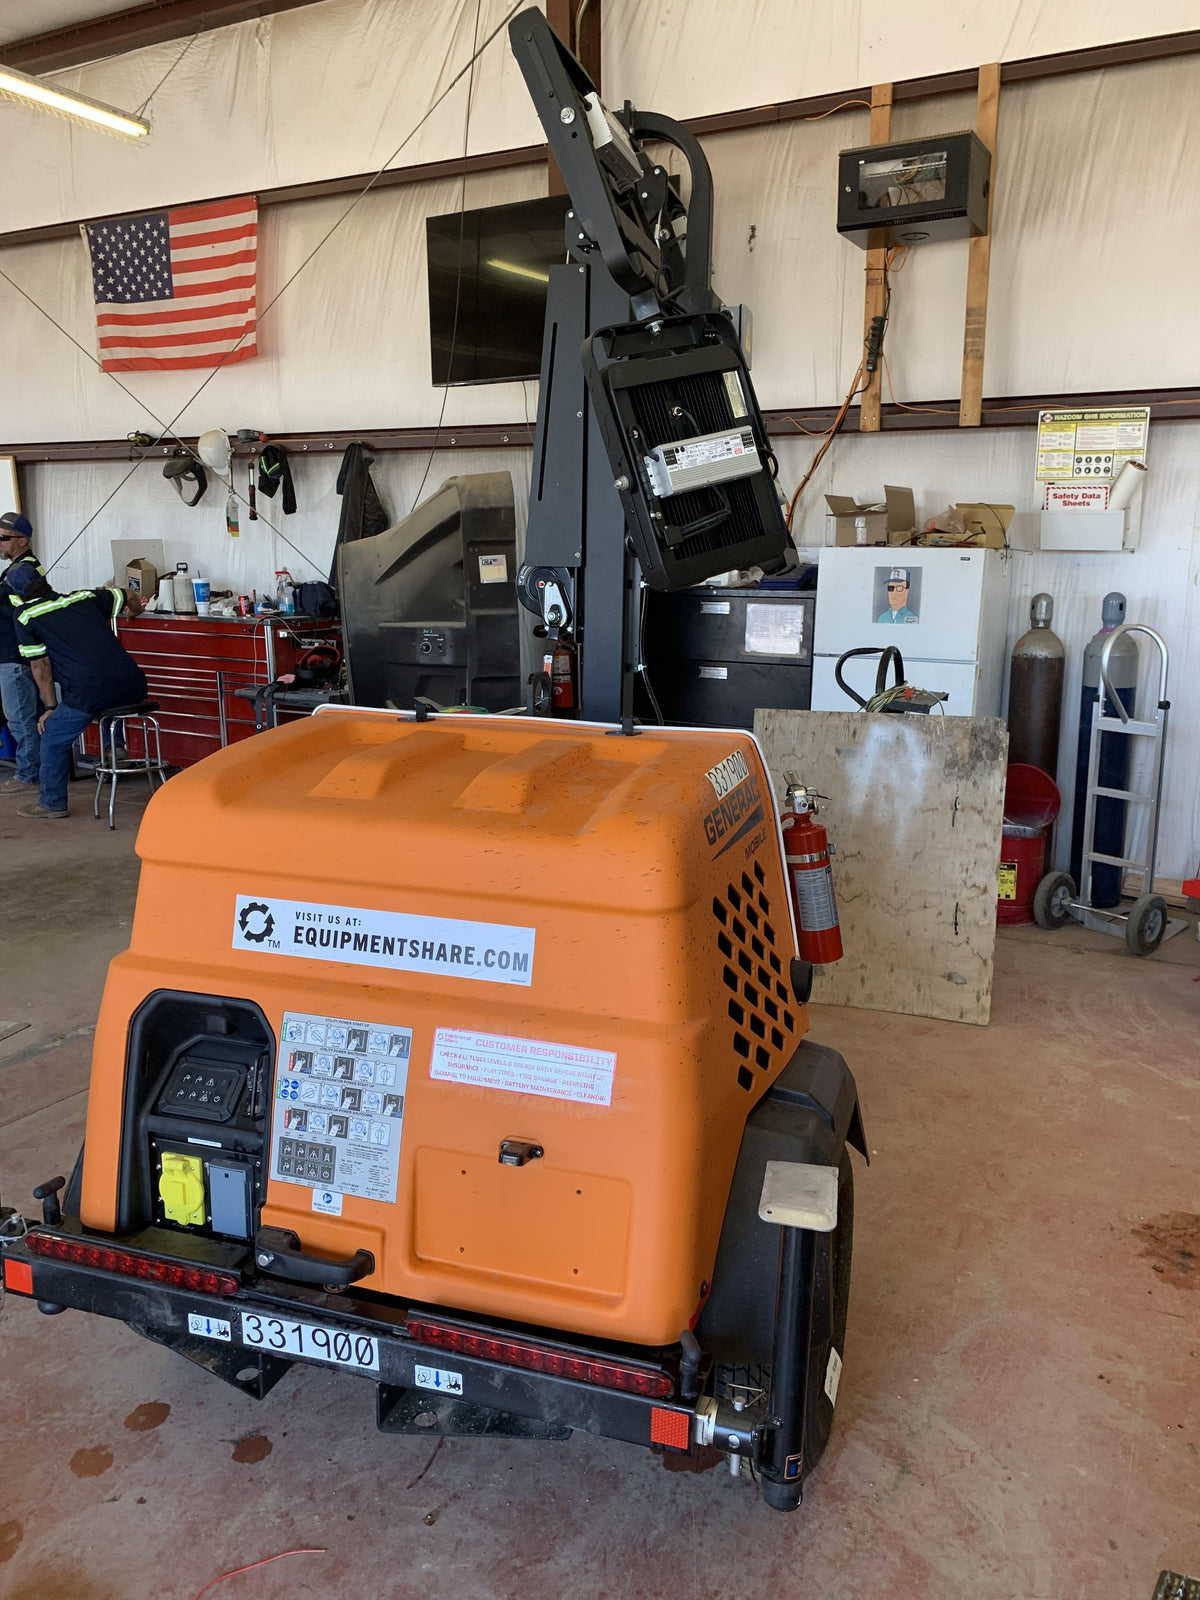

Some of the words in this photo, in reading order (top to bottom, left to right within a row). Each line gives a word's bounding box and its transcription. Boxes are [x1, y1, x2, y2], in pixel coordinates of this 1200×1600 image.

[708, 750, 748, 797] 331900
[704, 776, 760, 846] GENERAC
[745, 827, 768, 860] MOBILE
[295, 911, 323, 923] VISIT
[328, 914, 341, 924] US
[345, 917, 362, 927] AT:
[268, 939, 280, 948] TM
[293, 926, 529, 972] EQUIPMENTSHARE.COM
[475, 1039, 528, 1053] CUSTOMER
[530, 1046, 613, 1066] RESPONSIBILITY
[487, 1058, 506, 1066] LEVELS
[513, 1061, 536, 1070] GREASE
[554, 1068, 576, 1076] BEFORE
[577, 1071, 596, 1079] START
[434, 1069, 458, 1078] DAMAGE
[468, 1075, 500, 1085] EQUIPMENT
[504, 1080, 529, 1089] BATTERY
[530, 1084, 572, 1096] MAINTENANCE
[576, 1091, 606, 1101] CLEANING
[447, 1062, 479, 1071] INSURANCE
[498, 1069, 515, 1077] TIRES
[520, 1072, 532, 1080] TIRE
[534, 1074, 558, 1083] DAMAGE
[561, 1080, 595, 1089] REFUELING
[246, 1315, 374, 1365] 331900
